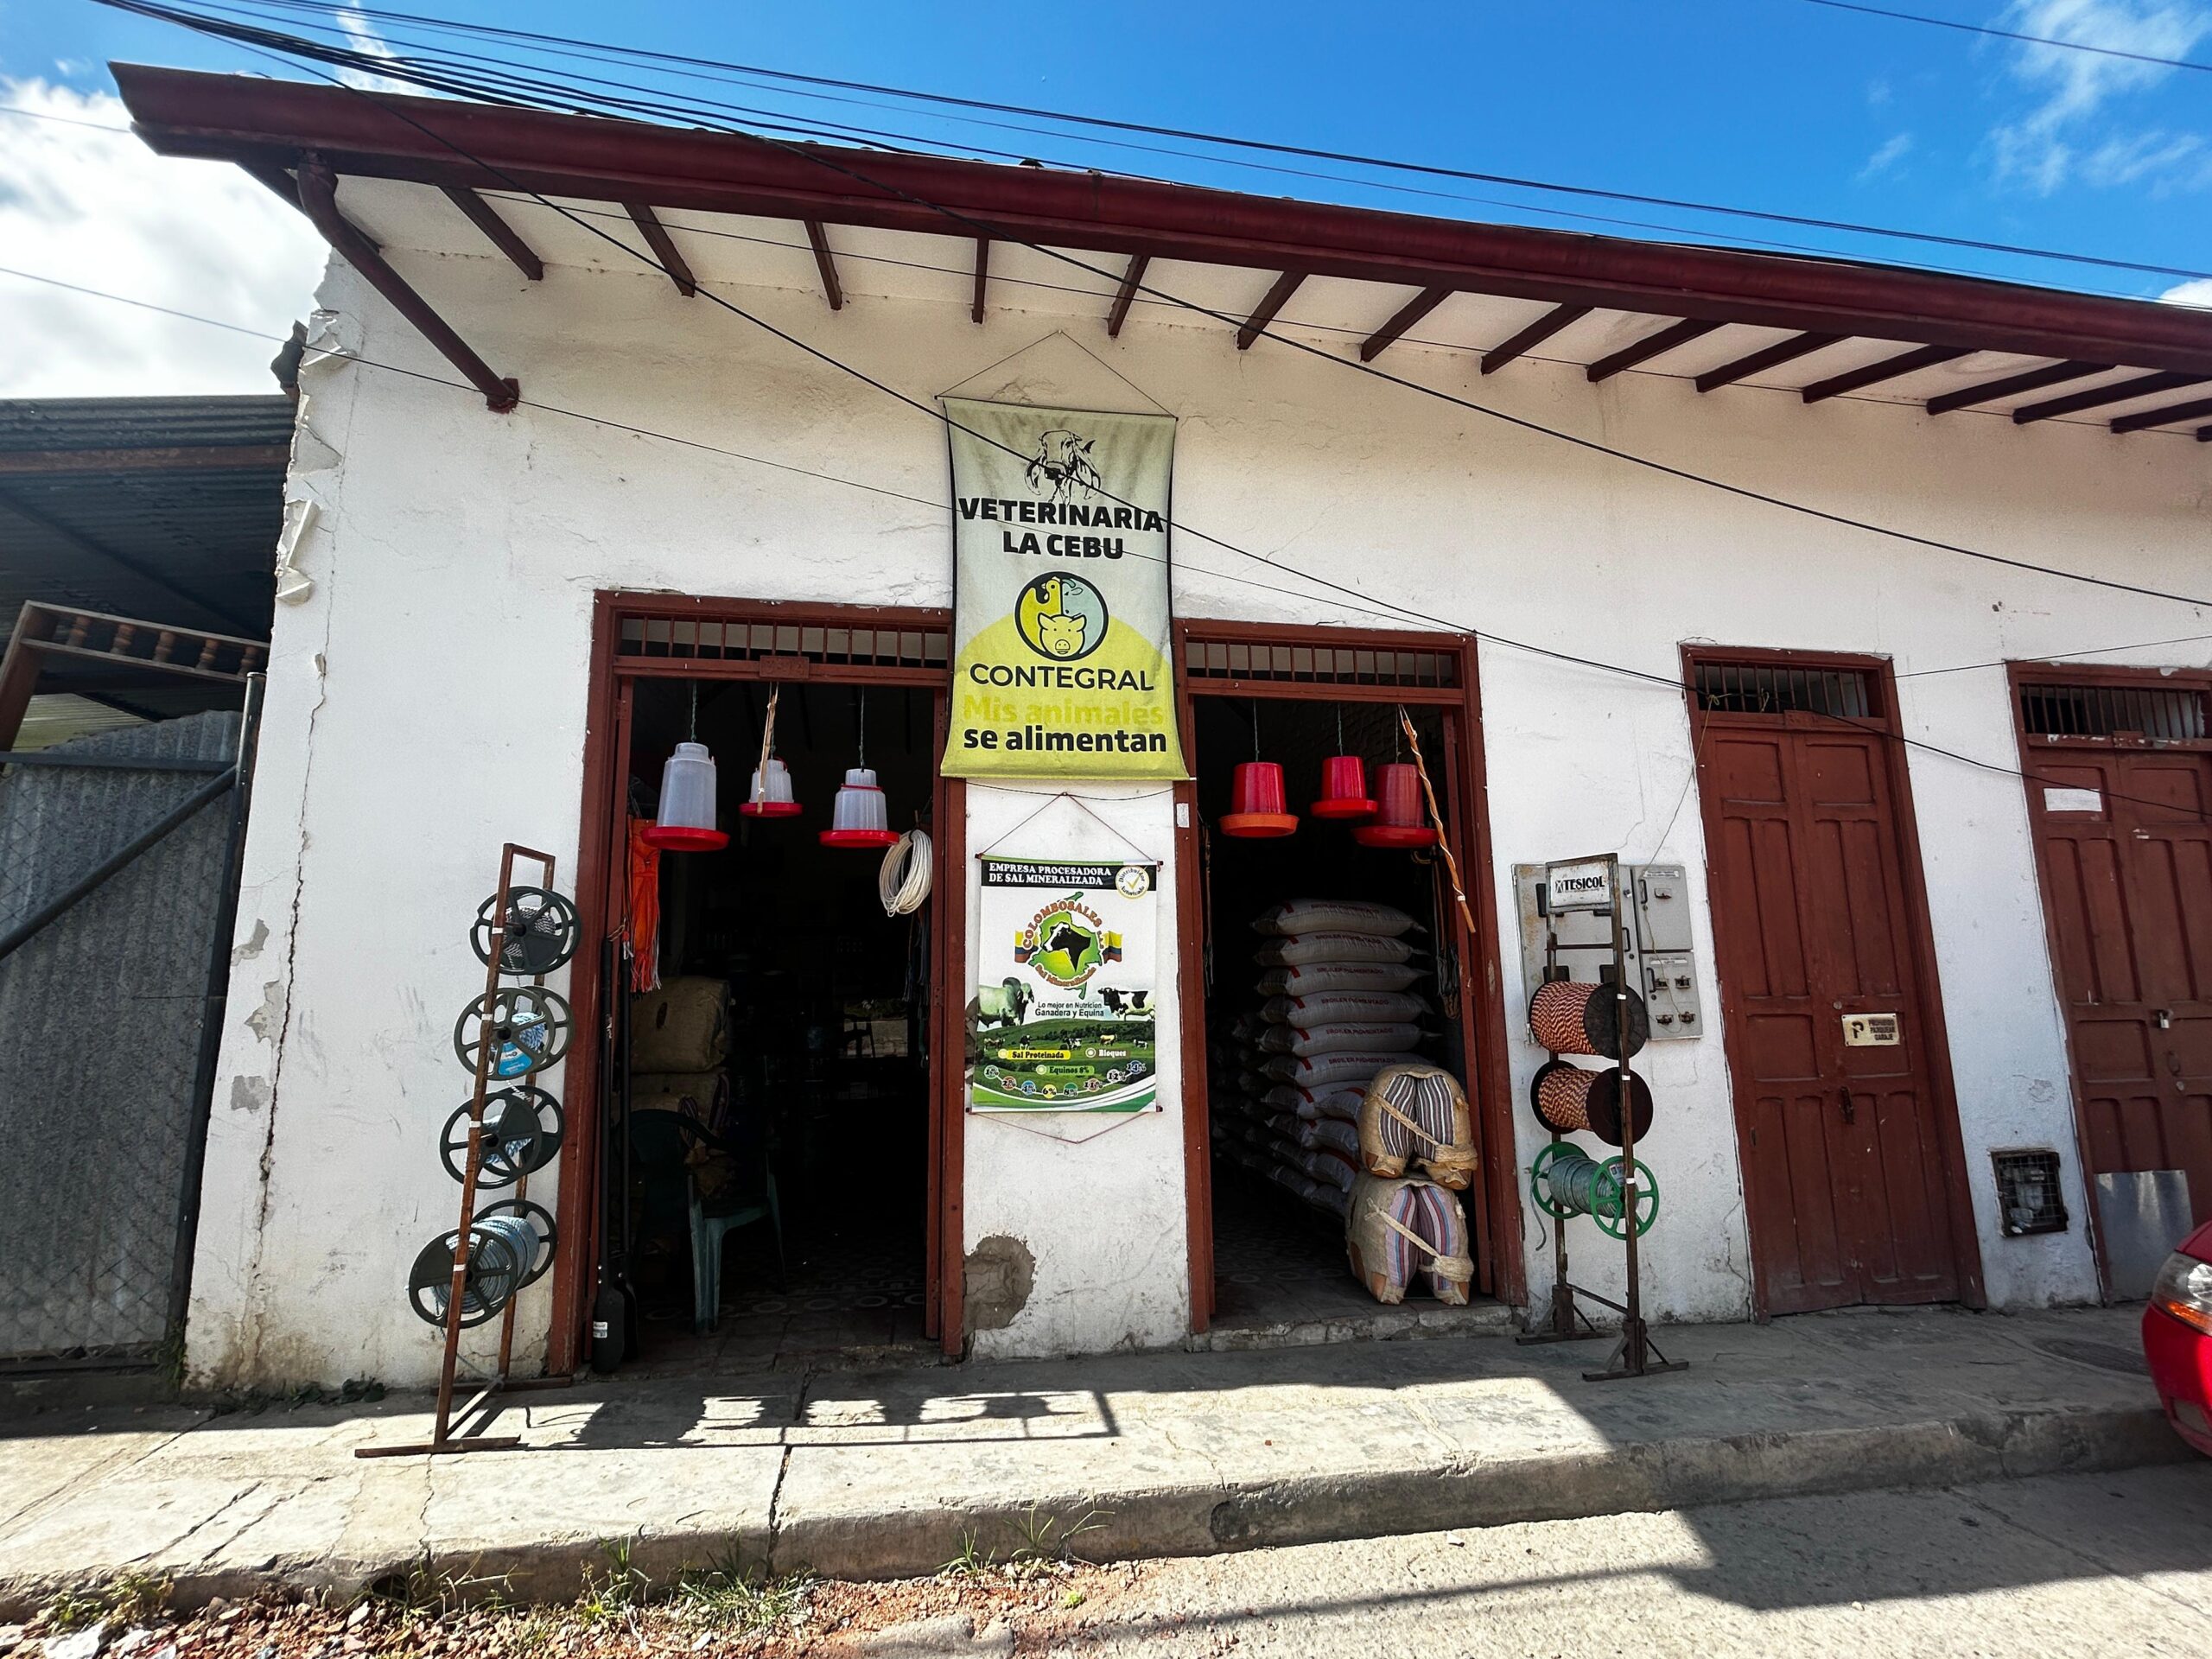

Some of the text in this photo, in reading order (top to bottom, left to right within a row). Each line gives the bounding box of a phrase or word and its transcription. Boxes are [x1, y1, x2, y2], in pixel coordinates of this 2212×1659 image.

[958, 498, 1165, 532] VETERINARIA
[1003, 531, 1123, 559] LA CEBU
[969, 663, 1154, 691] CONTEGRAL
[963, 694, 1163, 726] Mis animales
[963, 725, 1166, 752] se alimentan
[989, 863, 1111, 875] EMPRESA PROCESADORA
[989, 874, 1103, 885] DE SAL MINERALIZADA
[1563, 875, 1605, 891] TESICOL
[1023, 901, 1103, 949] COLOMBOSALES
[1079, 1008, 1104, 1018] Equina
[1050, 1066, 1077, 1075] Equinos
